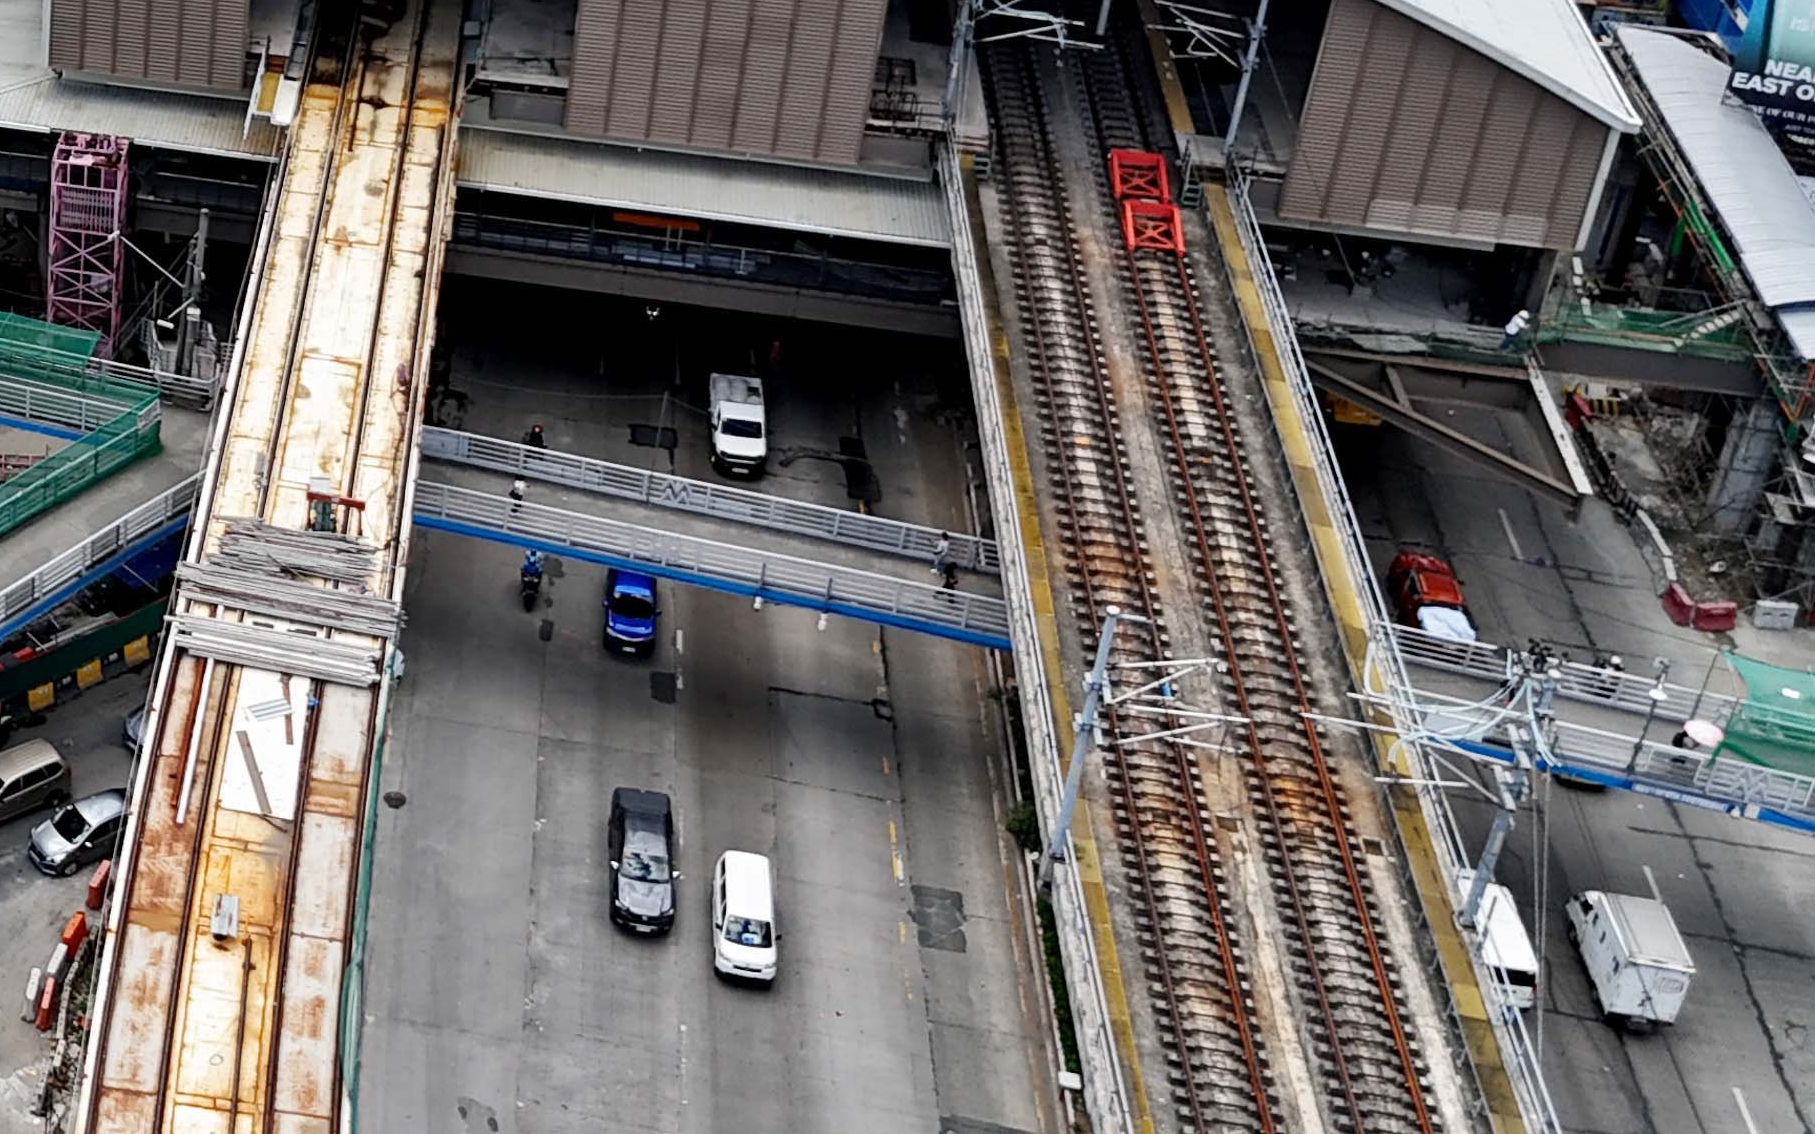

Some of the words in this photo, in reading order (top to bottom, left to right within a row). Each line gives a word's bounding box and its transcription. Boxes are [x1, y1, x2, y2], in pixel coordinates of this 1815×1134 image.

[1765, 59, 1815, 84] NEA
[1732, 72, 1794, 96] EAST
[1796, 84, 1815, 103] O
